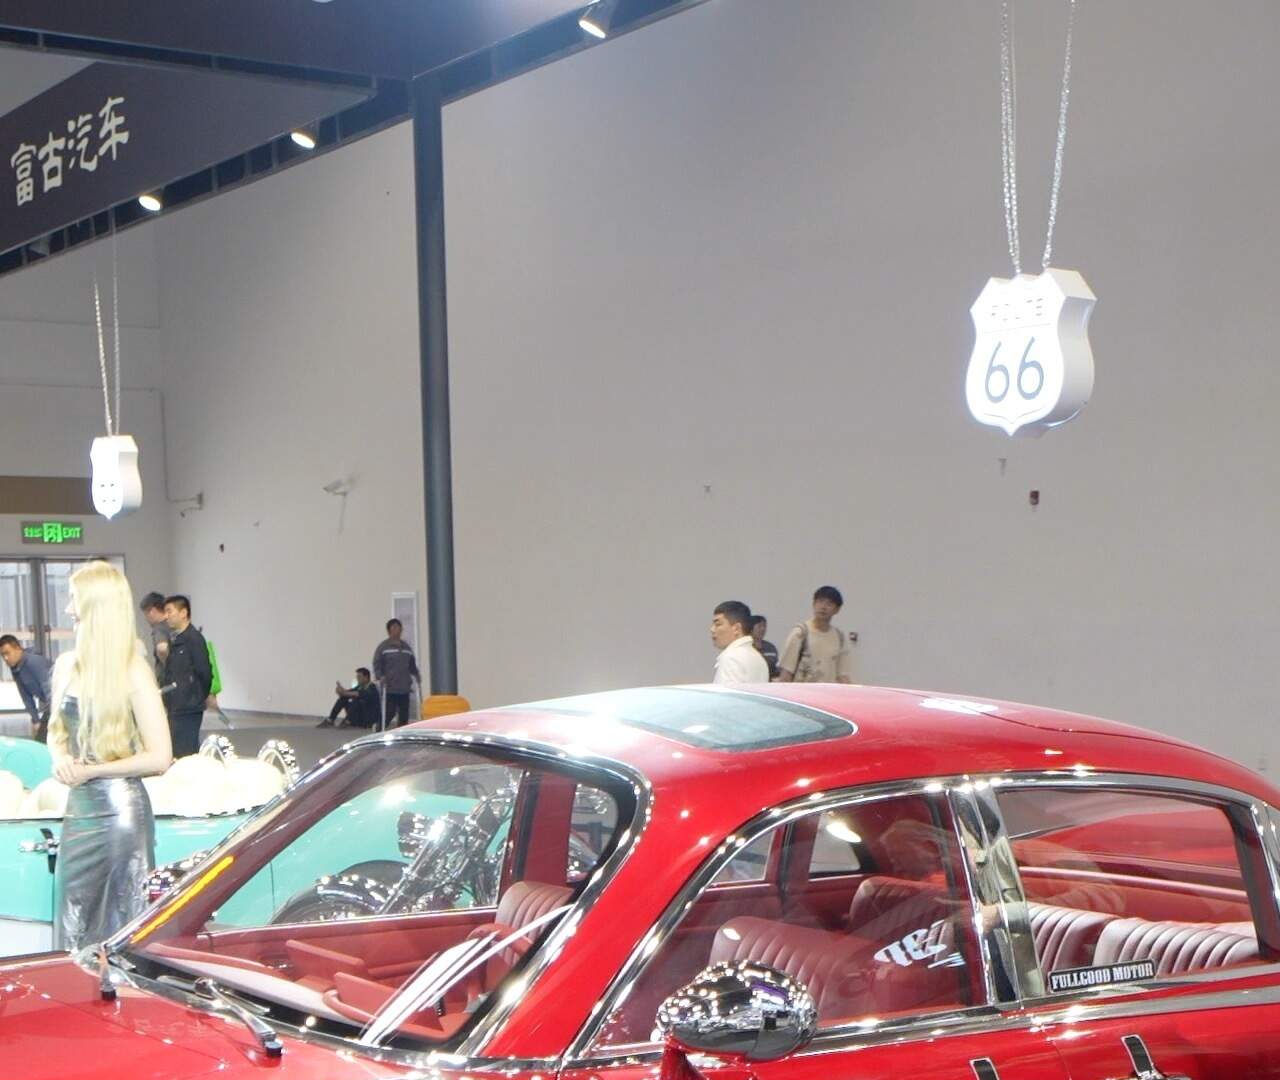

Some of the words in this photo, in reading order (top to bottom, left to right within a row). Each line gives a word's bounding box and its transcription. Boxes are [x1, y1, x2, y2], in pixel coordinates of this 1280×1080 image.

[10, 97, 130, 207] 富古汽车
[984, 336, 1044, 403] 66
[1051, 968, 1110, 990] FULLGOOD
[1112, 962, 1154, 982] MOTOR
